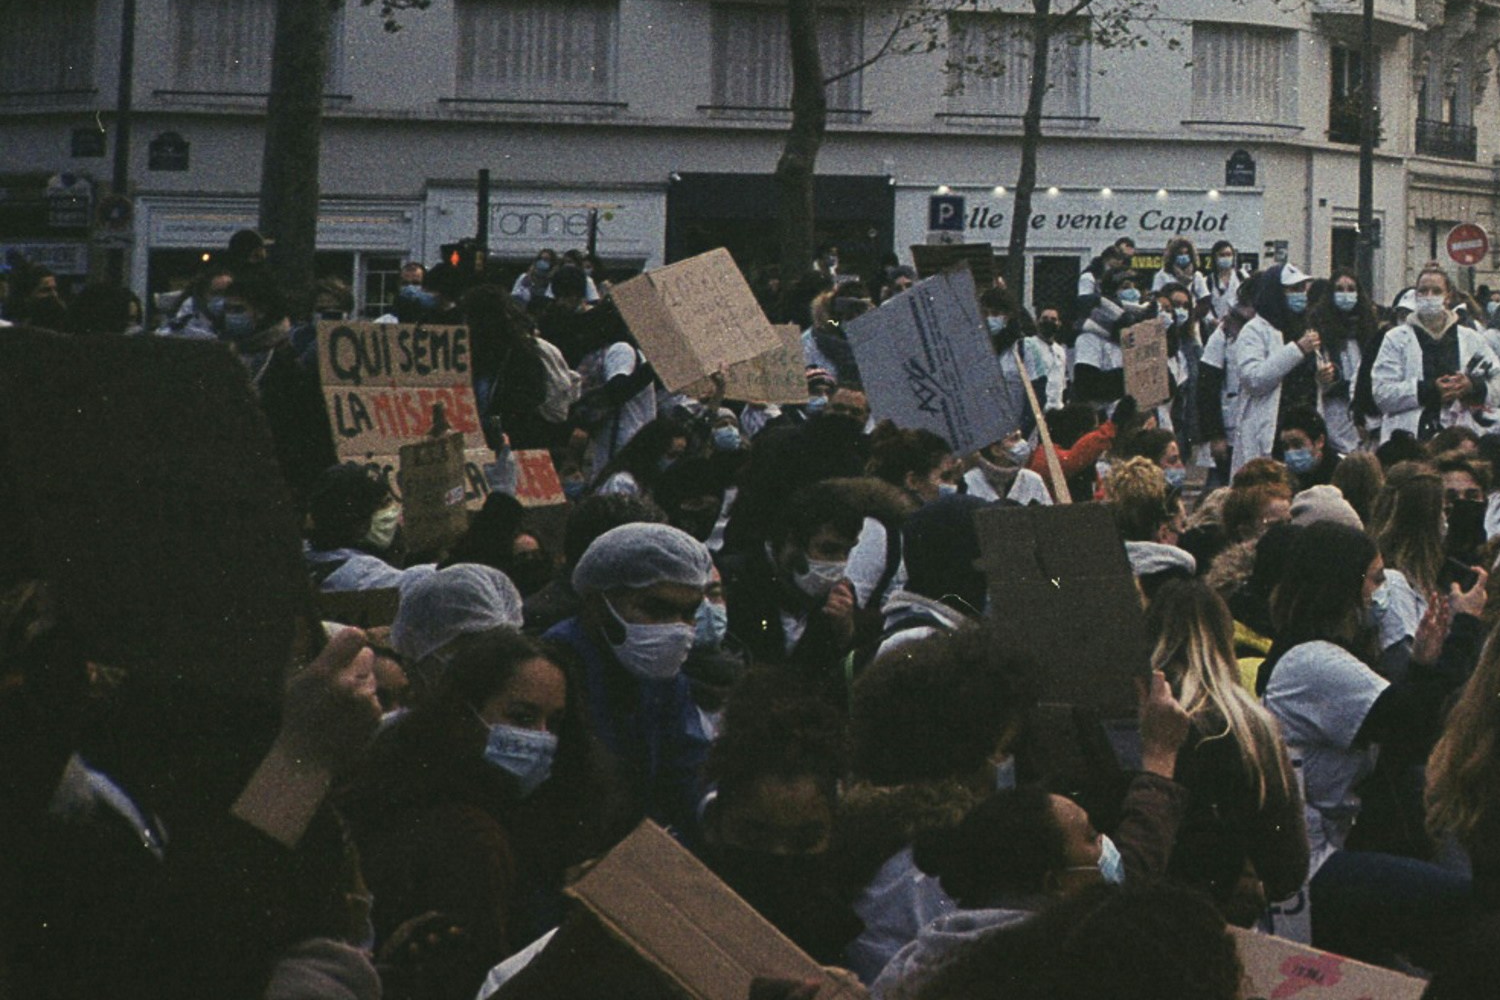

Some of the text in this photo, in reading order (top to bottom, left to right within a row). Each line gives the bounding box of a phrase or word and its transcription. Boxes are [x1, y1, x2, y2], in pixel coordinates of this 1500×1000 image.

[939, 202, 955, 225] P
[963, 206, 1005, 230] lle
[1055, 209, 1128, 231] vente
[1138, 209, 1230, 237] Caplot
[329, 325, 392, 385] QUI
[334, 392, 373, 438] LA
